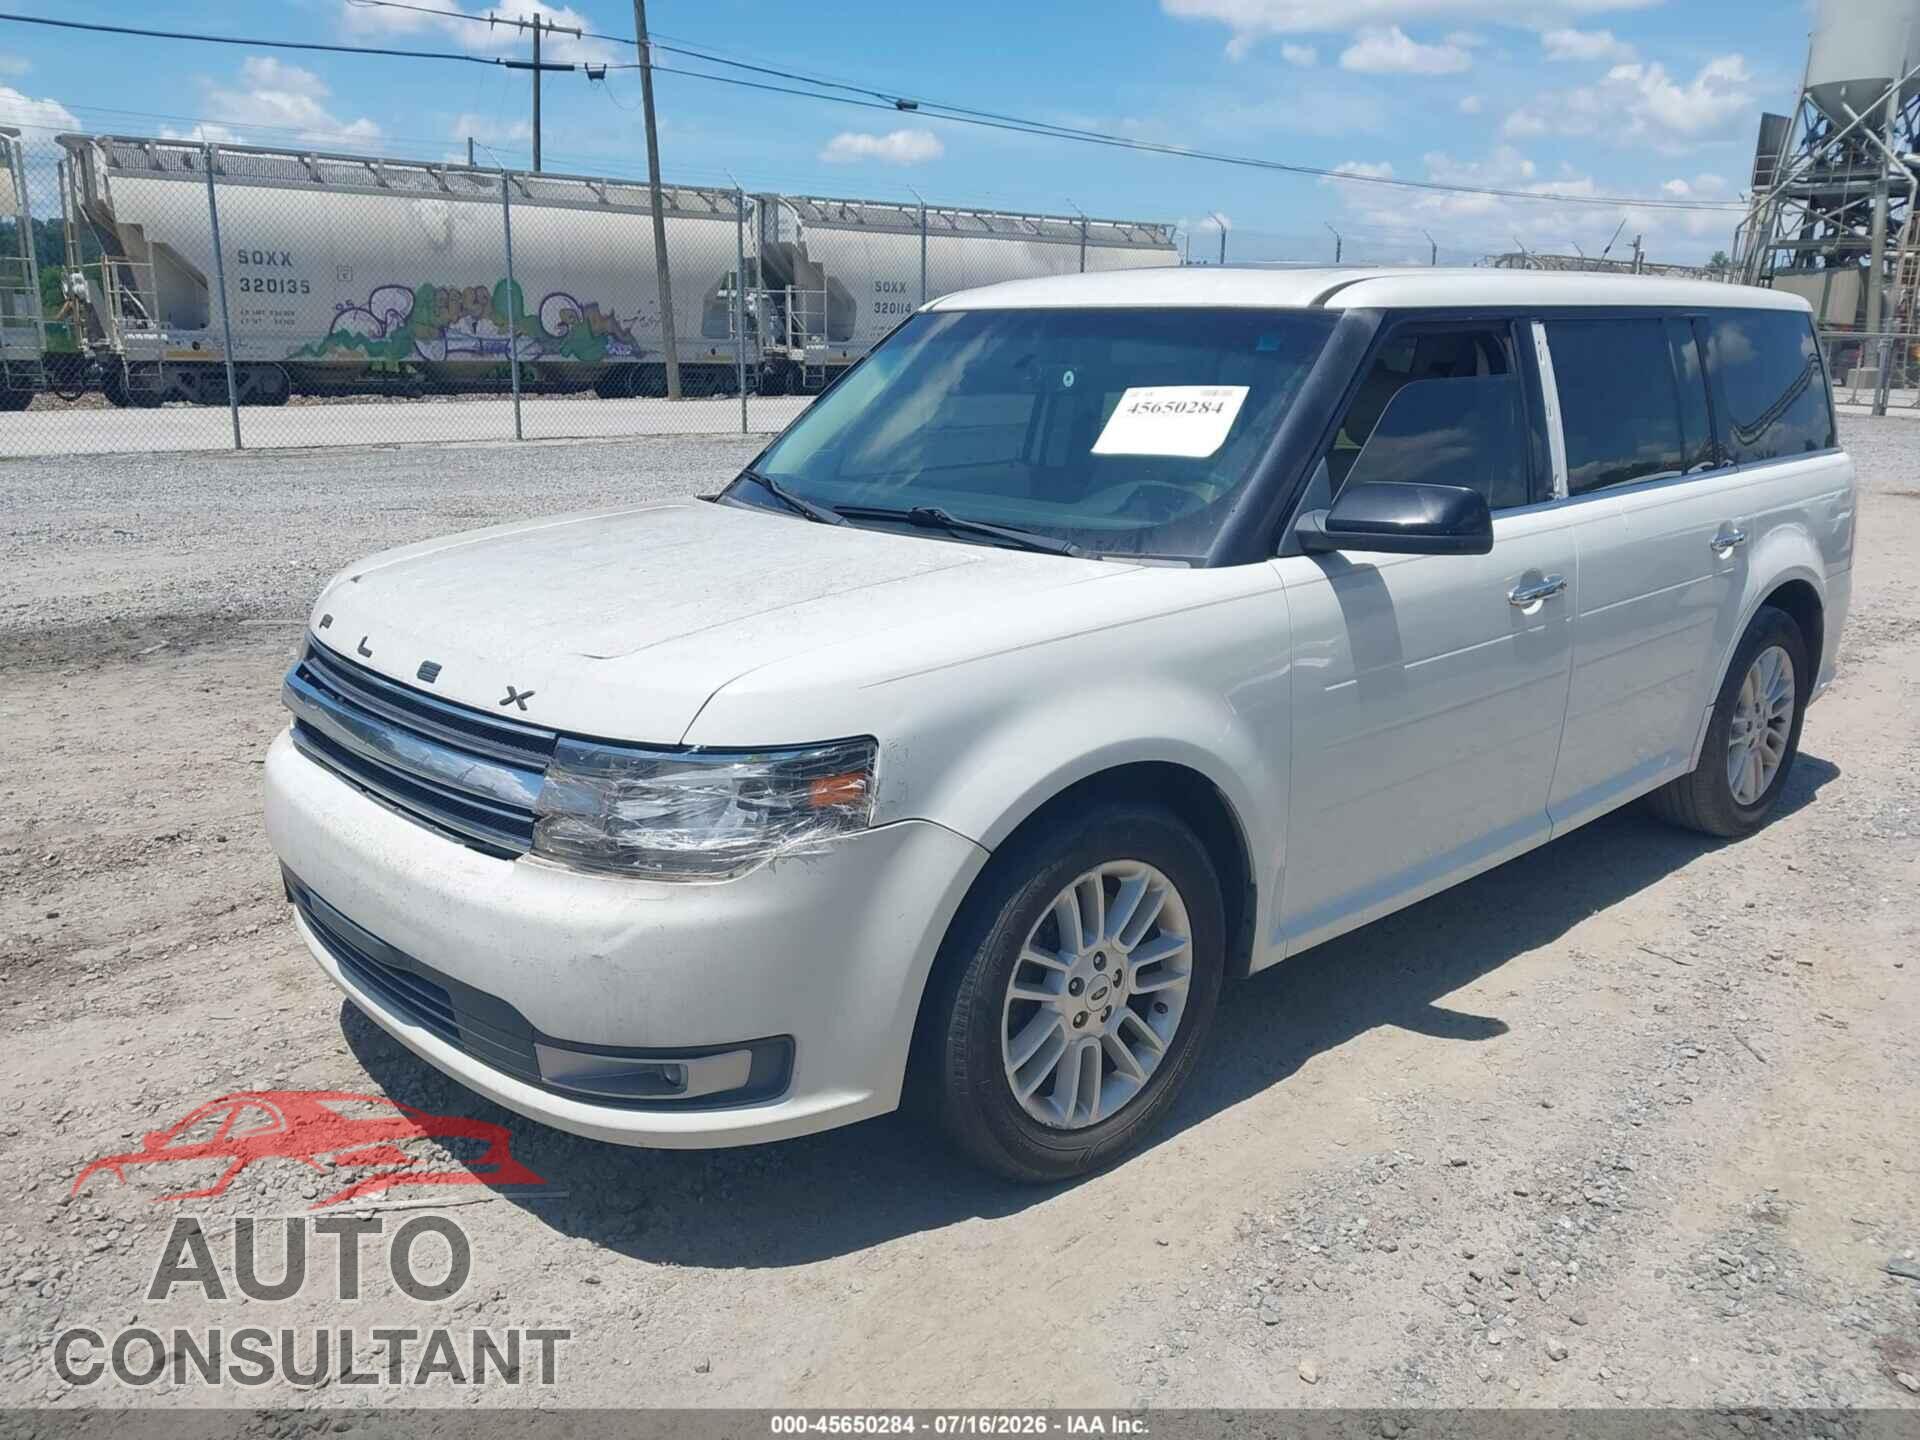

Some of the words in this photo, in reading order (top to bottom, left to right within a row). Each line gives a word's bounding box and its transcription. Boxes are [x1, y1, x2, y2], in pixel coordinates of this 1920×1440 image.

[238, 249, 293, 266] SOXX
[240, 278, 310, 294] 320135
[874, 281, 907, 293] SOXX
[1127, 401, 1225, 415] 45650284
